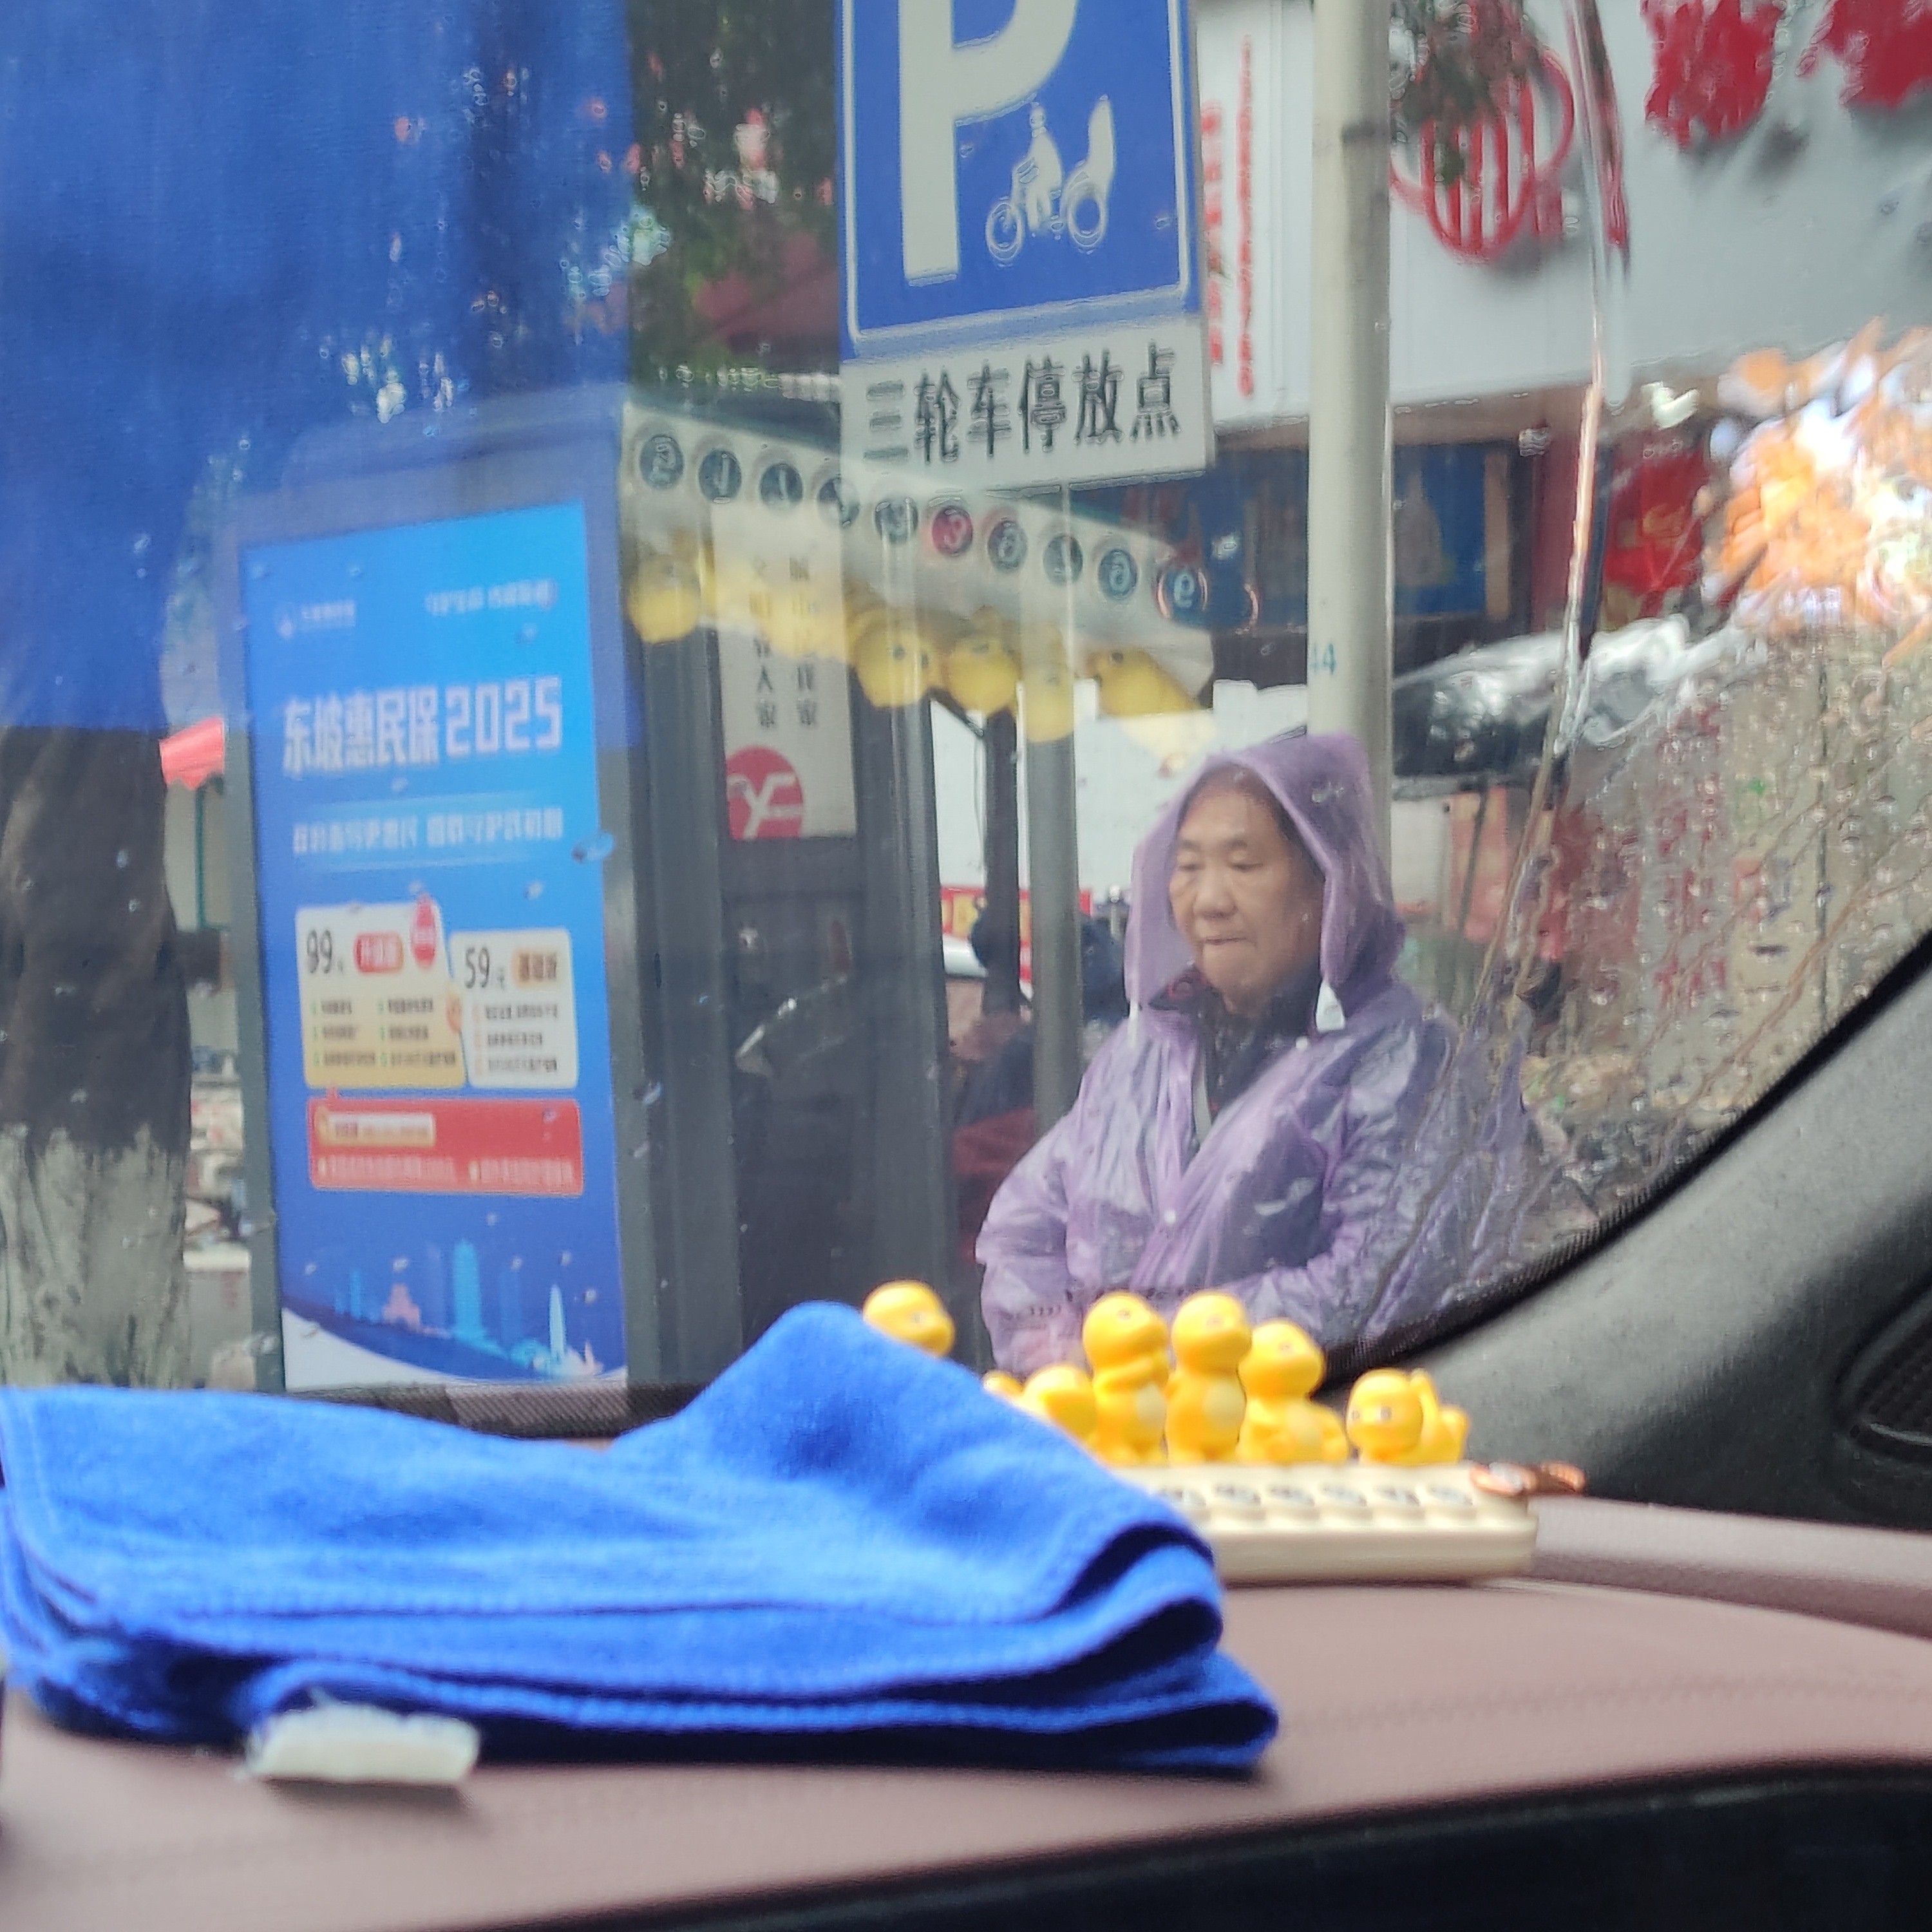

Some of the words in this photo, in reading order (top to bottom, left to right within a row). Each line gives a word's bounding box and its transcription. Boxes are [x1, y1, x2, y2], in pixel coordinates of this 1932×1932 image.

[899, 0, 1078, 287] P
[862, 340, 1181, 464] 三轮车停放点
